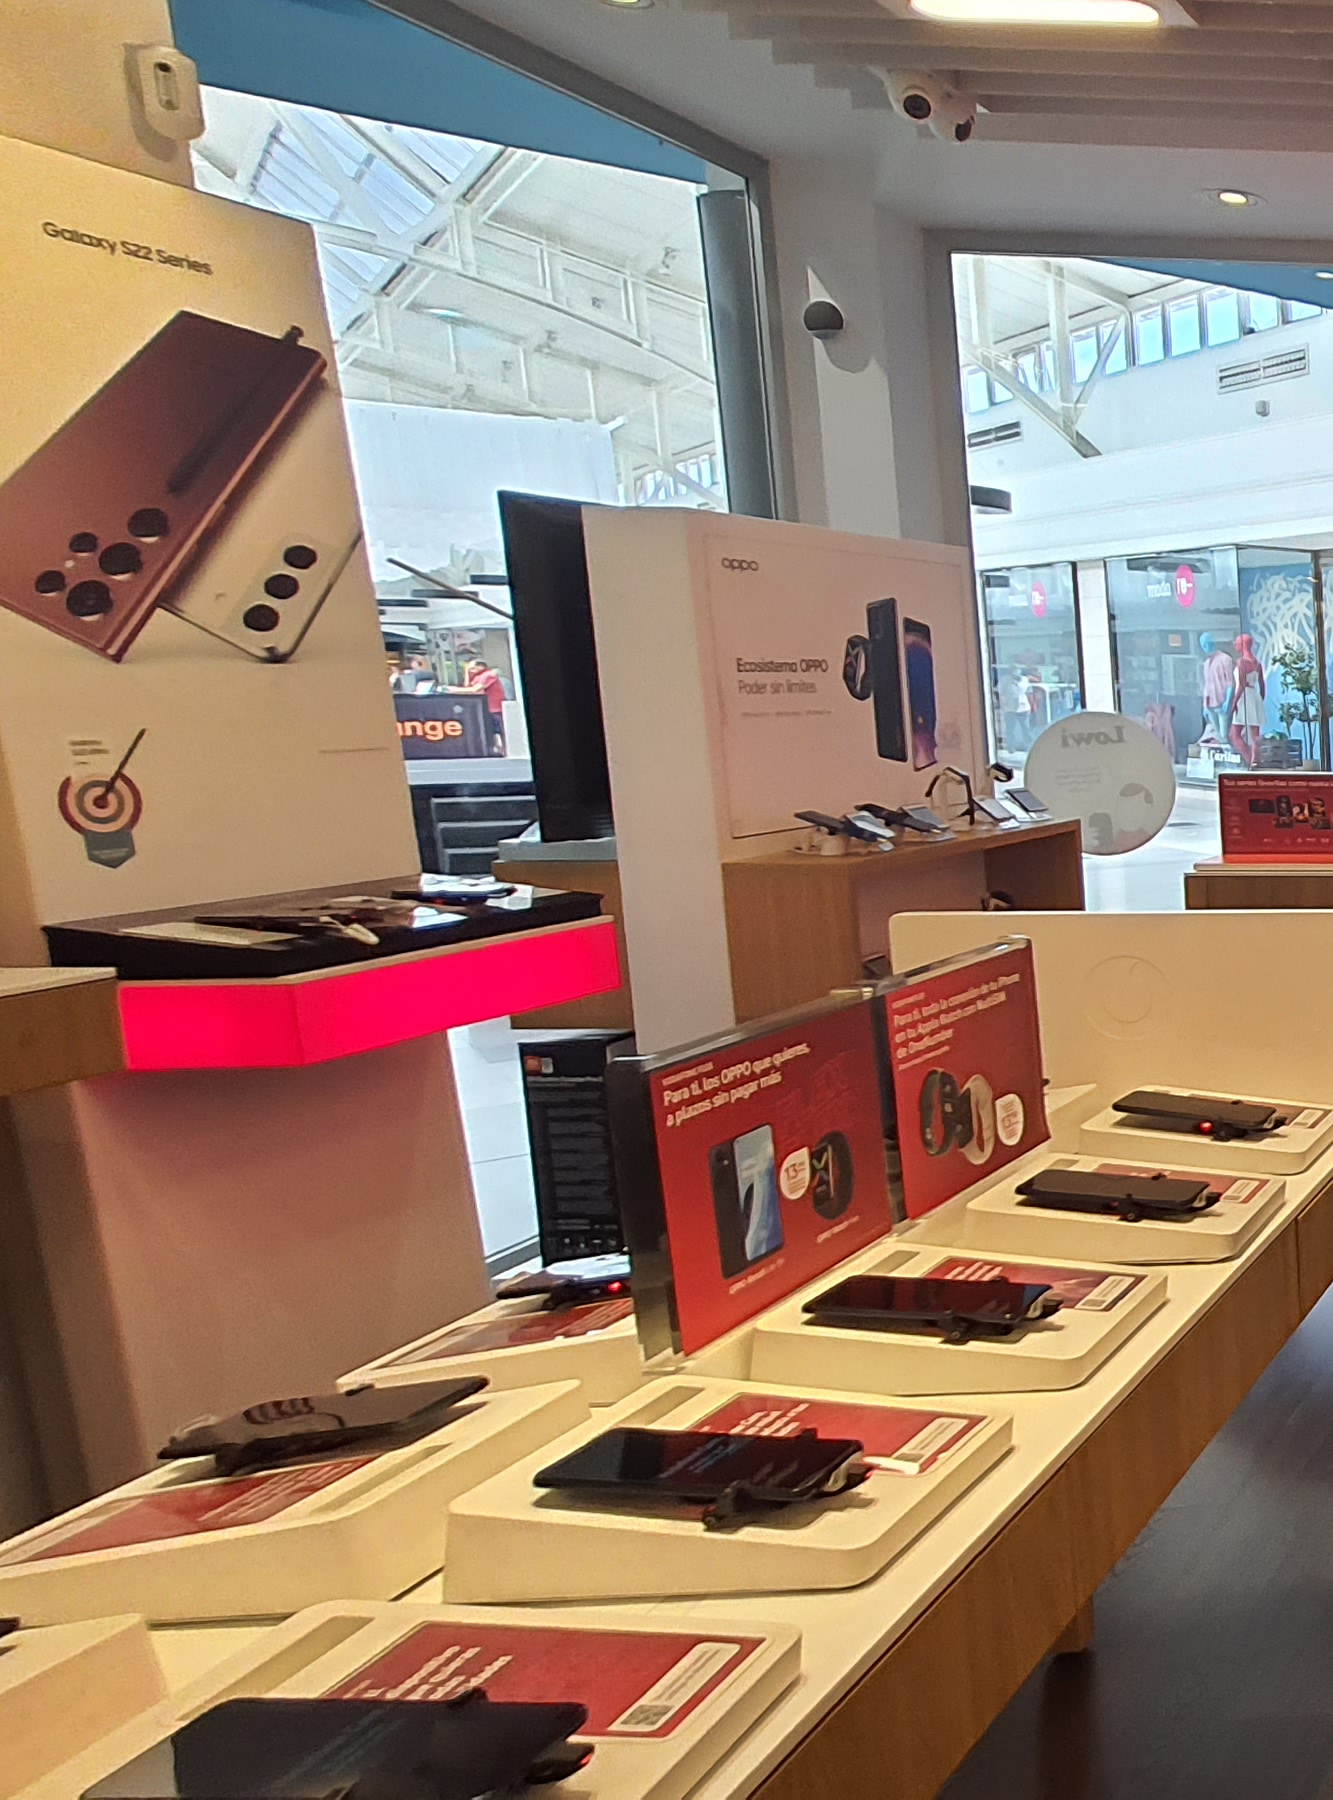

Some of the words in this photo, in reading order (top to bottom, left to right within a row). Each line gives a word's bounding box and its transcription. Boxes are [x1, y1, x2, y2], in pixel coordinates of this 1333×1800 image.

[42, 221, 117, 256] Galaxy
[120, 240, 154, 262] S22
[156, 249, 213, 275] Series
[736, 657, 798, 674] Ecosistema
[800, 658, 829, 673] OPPO
[738, 679, 768, 695] Poder
[770, 680, 785, 695] sin
[396, 720, 463, 741] nge
[663, 1087, 690, 1106] Para
[703, 1075, 720, 1091] los
[721, 1061, 752, 1084] OPPO
[753, 1056, 772, 1074] que
[666, 1114, 675, 1127] a
[675, 1098, 712, 1126] plazos
[712, 1090, 730, 1107] sin
[730, 1080, 759, 1104] pagar
